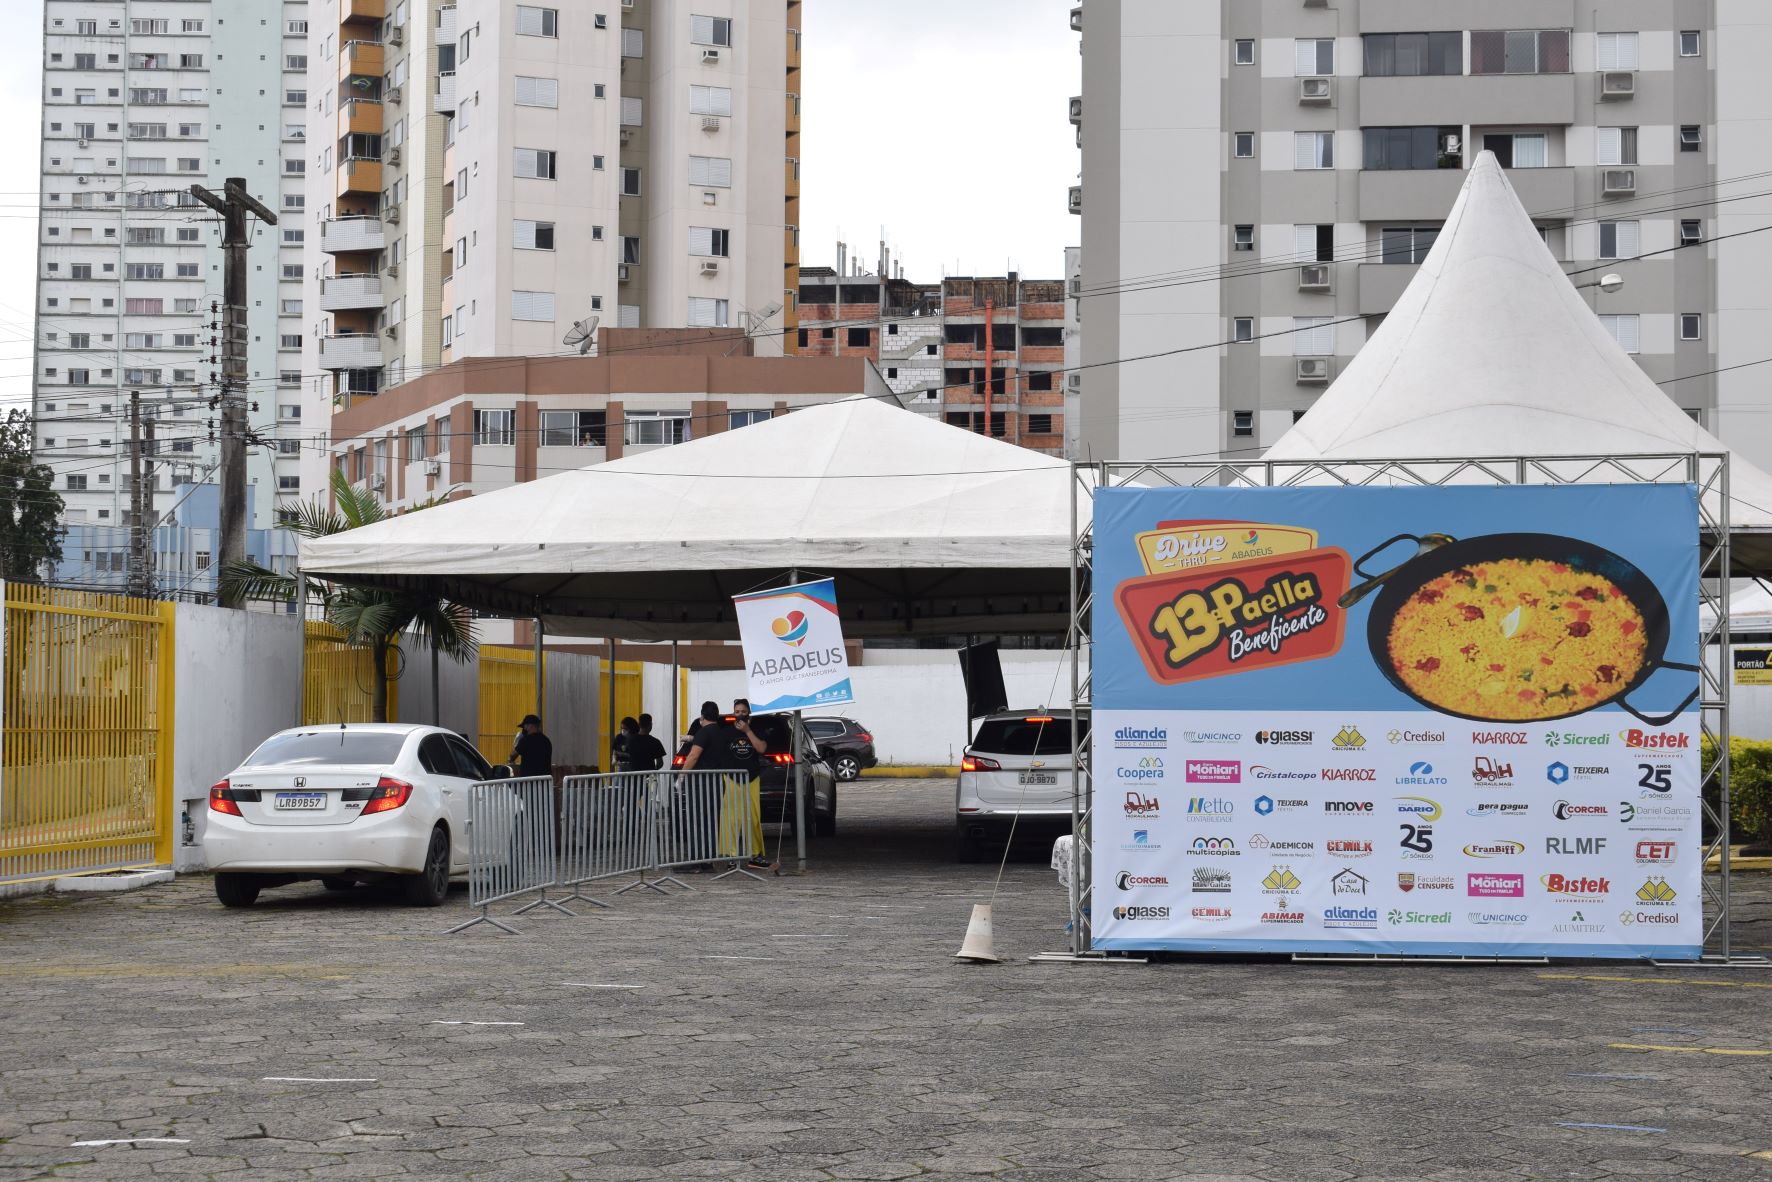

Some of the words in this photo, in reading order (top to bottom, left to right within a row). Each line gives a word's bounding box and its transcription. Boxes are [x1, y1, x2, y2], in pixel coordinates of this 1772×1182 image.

[1154, 532, 1228, 561] Drive
[1231, 547, 1273, 560] ABADEUS
[1178, 556, 1207, 567] THRU
[1210, 578, 1315, 629] Paella
[1229, 604, 1326, 659] Beneficente
[751, 647, 843, 678] ABADEUS
[1737, 660, 1764, 668] PORTÃO
[1115, 727, 1166, 739] alianda
[1198, 732, 1241, 740] UNICINCO
[1270, 730, 1312, 744] giassi
[1404, 730, 1445, 742] Credisol
[1472, 732, 1528, 744] KIARROZ
[1563, 733, 1610, 745] Sicredi
[1626, 728, 1690, 748] Bistek
[1118, 767, 1164, 780] Coopera
[1189, 764, 1238, 775] Moniari
[1322, 768, 1376, 781] KIARROZ
[1573, 766, 1609, 774] TEIXEIRA
[1256, 772, 1316, 780] Cristalcopo
[1638, 764, 1672, 793] 25
[279, 798, 321, 808] LRB9B57
[1188, 798, 1234, 814] Netto
[1325, 802, 1374, 812] innove
[1636, 806, 1662, 814] Daniel
[1664, 806, 1691, 814] Garcia
[1400, 824, 1432, 853] 25
[1327, 840, 1372, 852] GEMILK
[1472, 845, 1516, 855] FranBiff
[1546, 838, 1607, 854] RLMF
[1636, 842, 1676, 858] CET
[1130, 876, 1168, 884] CORCRIL
[1340, 876, 1358, 884] Casa
[1470, 876, 1521, 888] Moniari
[1547, 874, 1610, 893] Bistek
[1338, 885, 1344, 894] do
[1344, 885, 1360, 894] Doce
[1128, 906, 1170, 920] giassi
[1192, 908, 1232, 917] GEMILK
[1324, 906, 1377, 919] alianda
[1406, 912, 1452, 924] Sicredi
[1482, 914, 1528, 922] UNICINCO
[1636, 912, 1678, 924] Credisol
